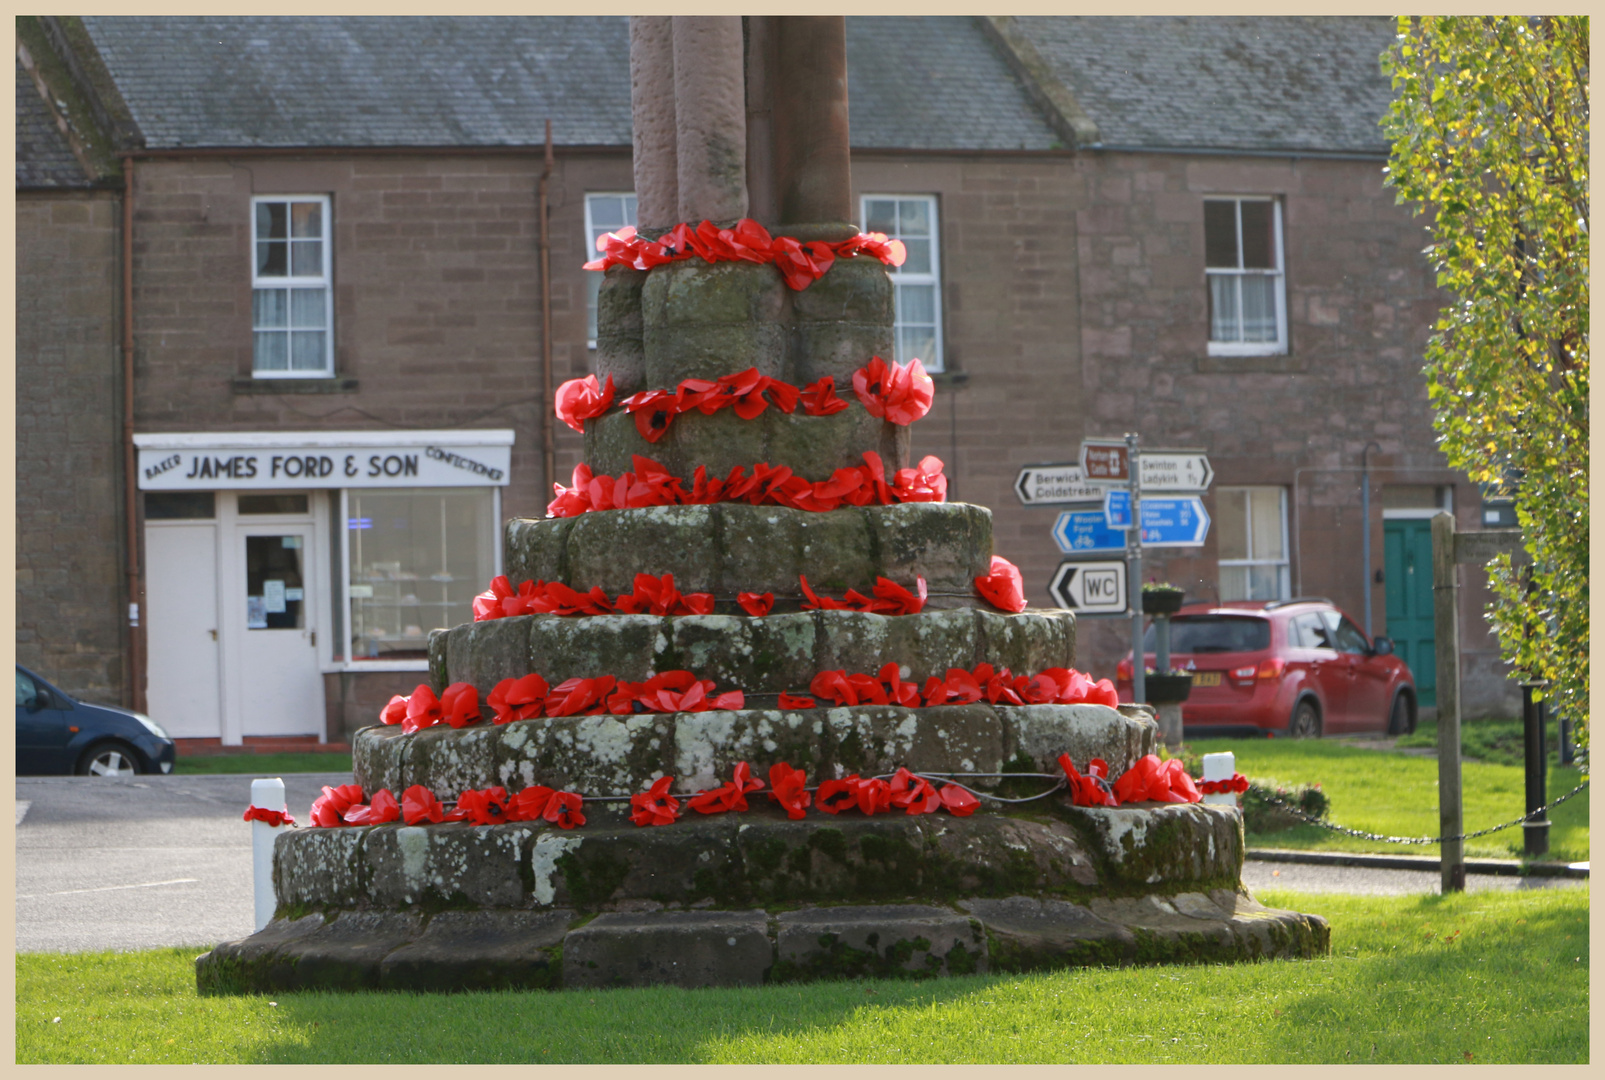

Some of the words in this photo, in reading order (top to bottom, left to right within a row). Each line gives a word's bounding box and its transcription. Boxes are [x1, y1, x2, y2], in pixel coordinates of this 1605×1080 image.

[145, 454, 182, 480] BAKER
[186, 456, 258, 479] JAMES
[271, 456, 334, 479] FORD
[344, 455, 358, 478] &
[368, 455, 419, 478] SON
[426, 446, 504, 481] CONFECTIONER
[1142, 460, 1177, 470] Swinton
[1186, 460, 1192, 470] 4
[1036, 473, 1081, 485] Berwick
[1142, 473, 1179, 486] Ladykirk
[1036, 486, 1101, 498] Coldstream
[1073, 515, 1104, 523] Wooler
[1073, 525, 1093, 533] Ford
[1087, 578, 1114, 597] WC
